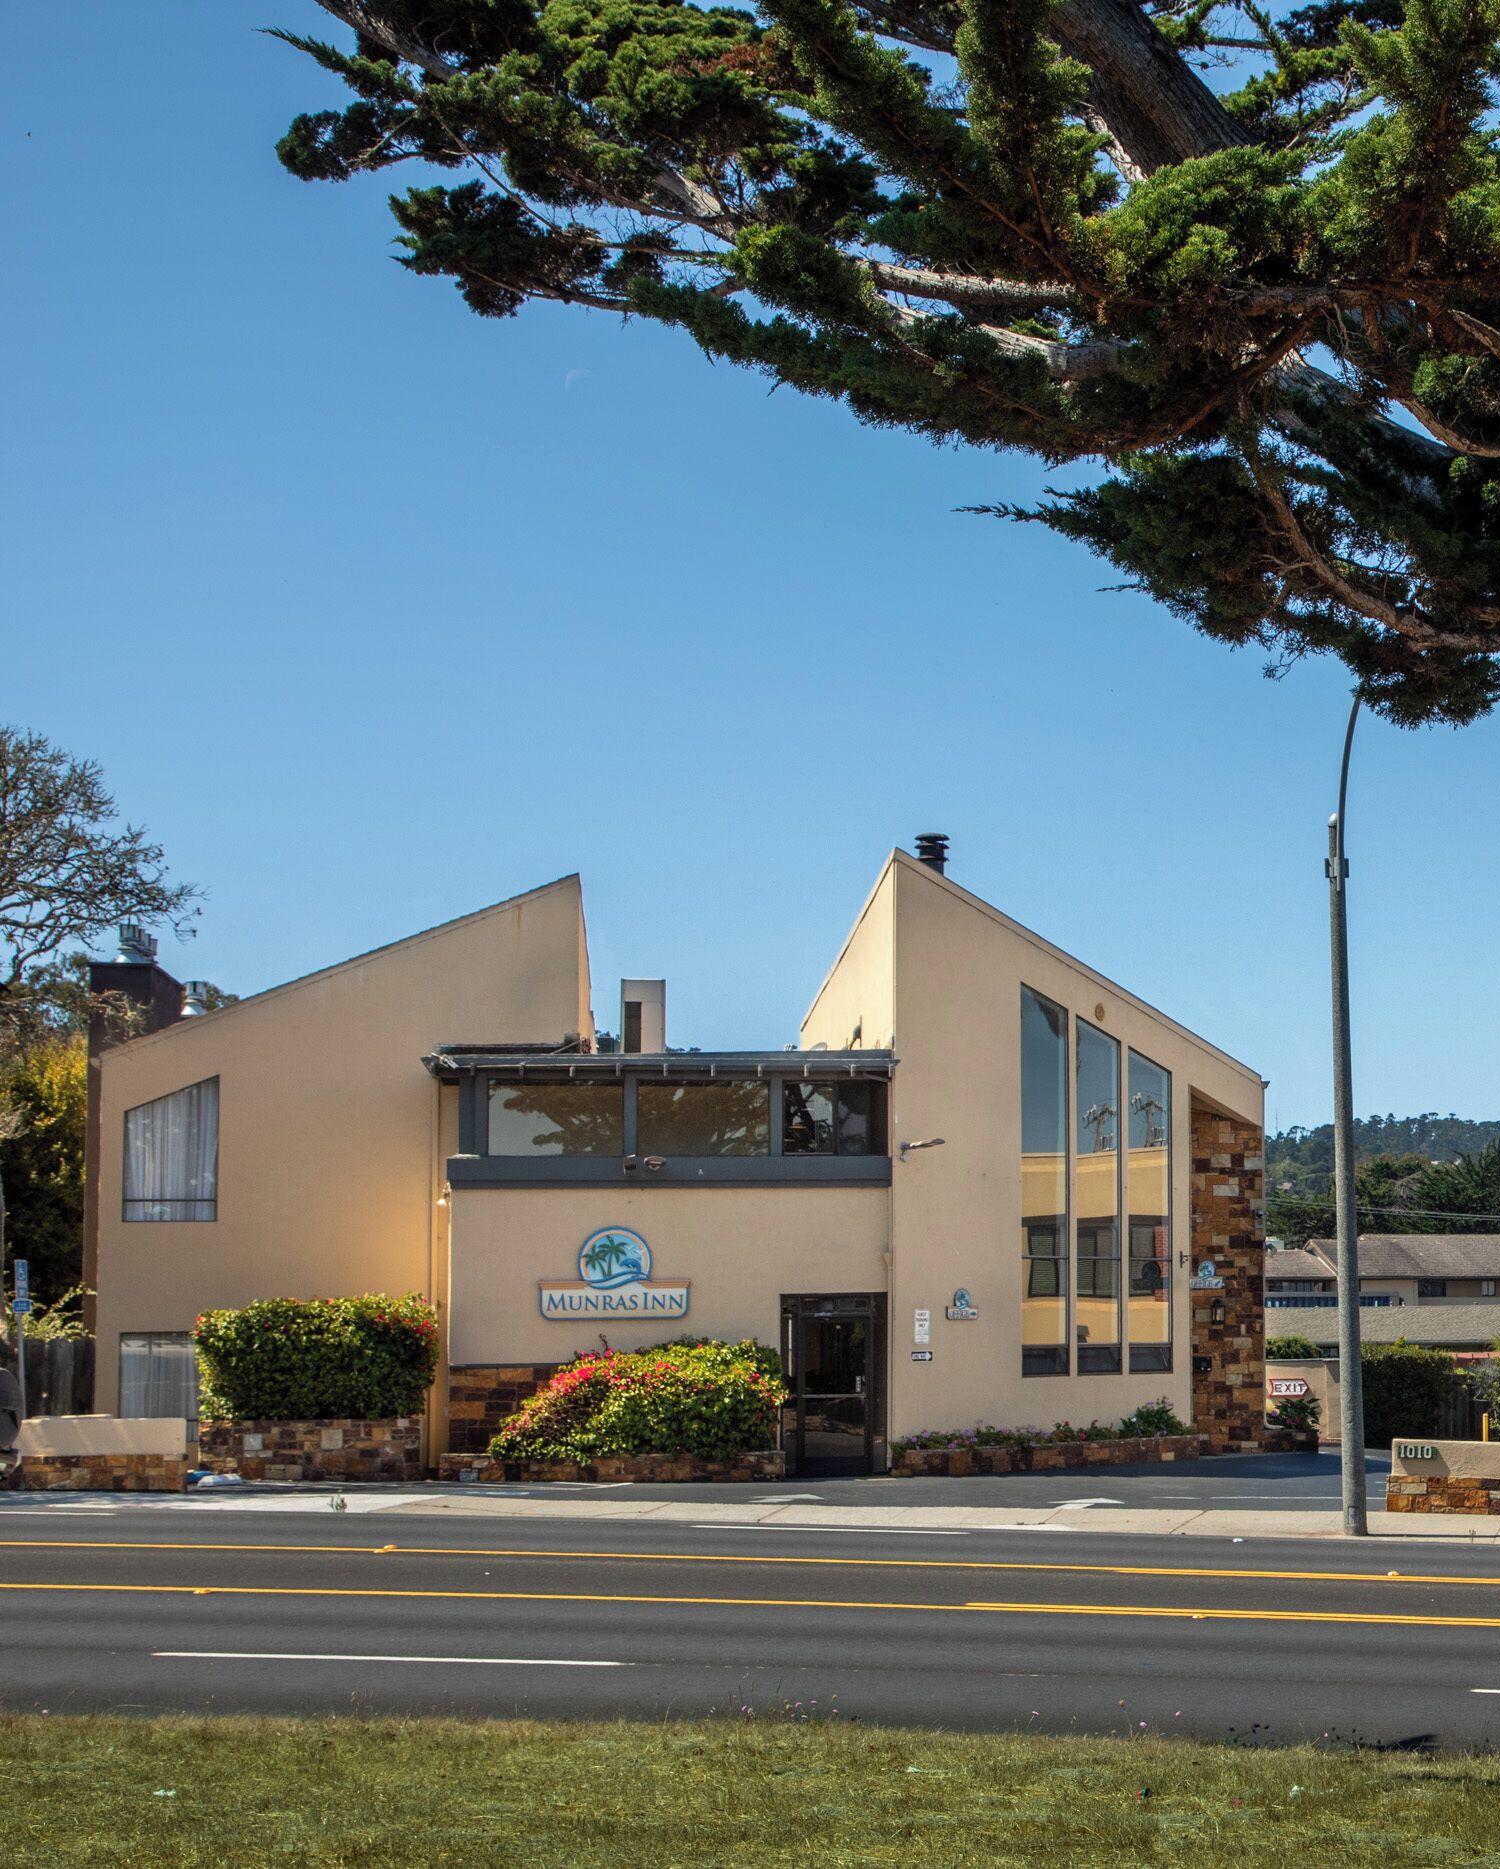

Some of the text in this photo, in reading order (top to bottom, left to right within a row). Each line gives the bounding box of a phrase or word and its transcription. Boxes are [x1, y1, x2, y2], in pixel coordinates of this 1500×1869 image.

[547, 1292, 684, 1311] MUNRAS INN
[1274, 1383, 1304, 1393] EXIT
[1400, 1445, 1432, 1458] 1010
